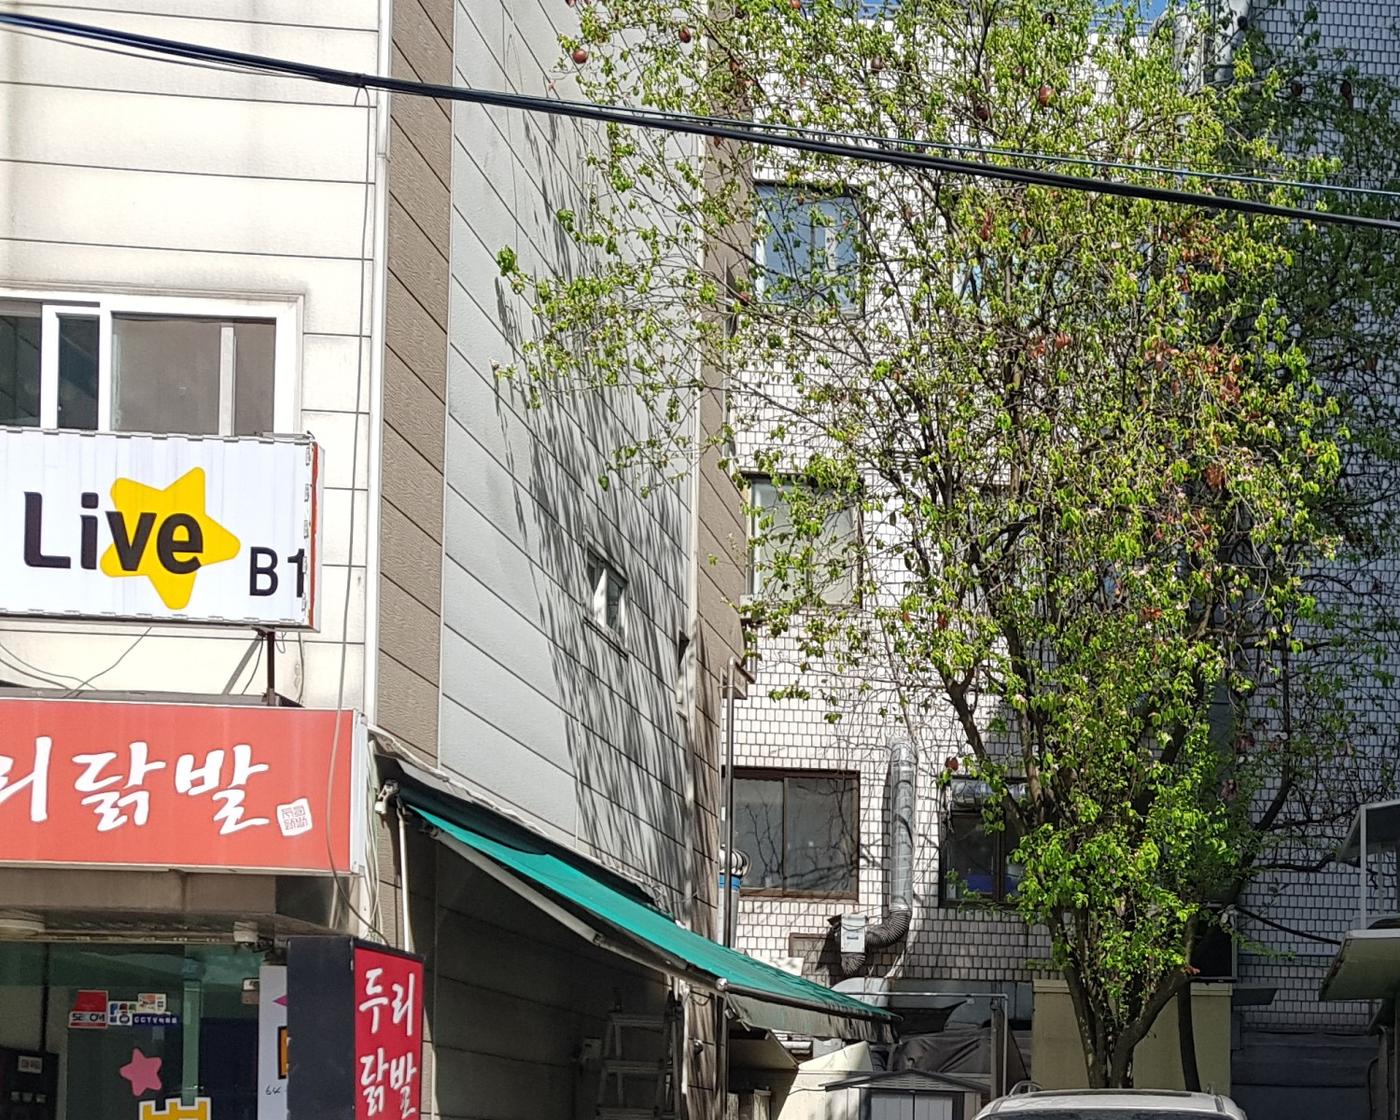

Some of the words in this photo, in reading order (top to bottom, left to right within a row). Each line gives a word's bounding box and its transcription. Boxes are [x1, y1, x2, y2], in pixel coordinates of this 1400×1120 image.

[24, 491, 204, 575] Live
[250, 546, 306, 598] B1
[359, 968, 416, 1037] 두리
[360, 1047, 417, 1120] 닭발
